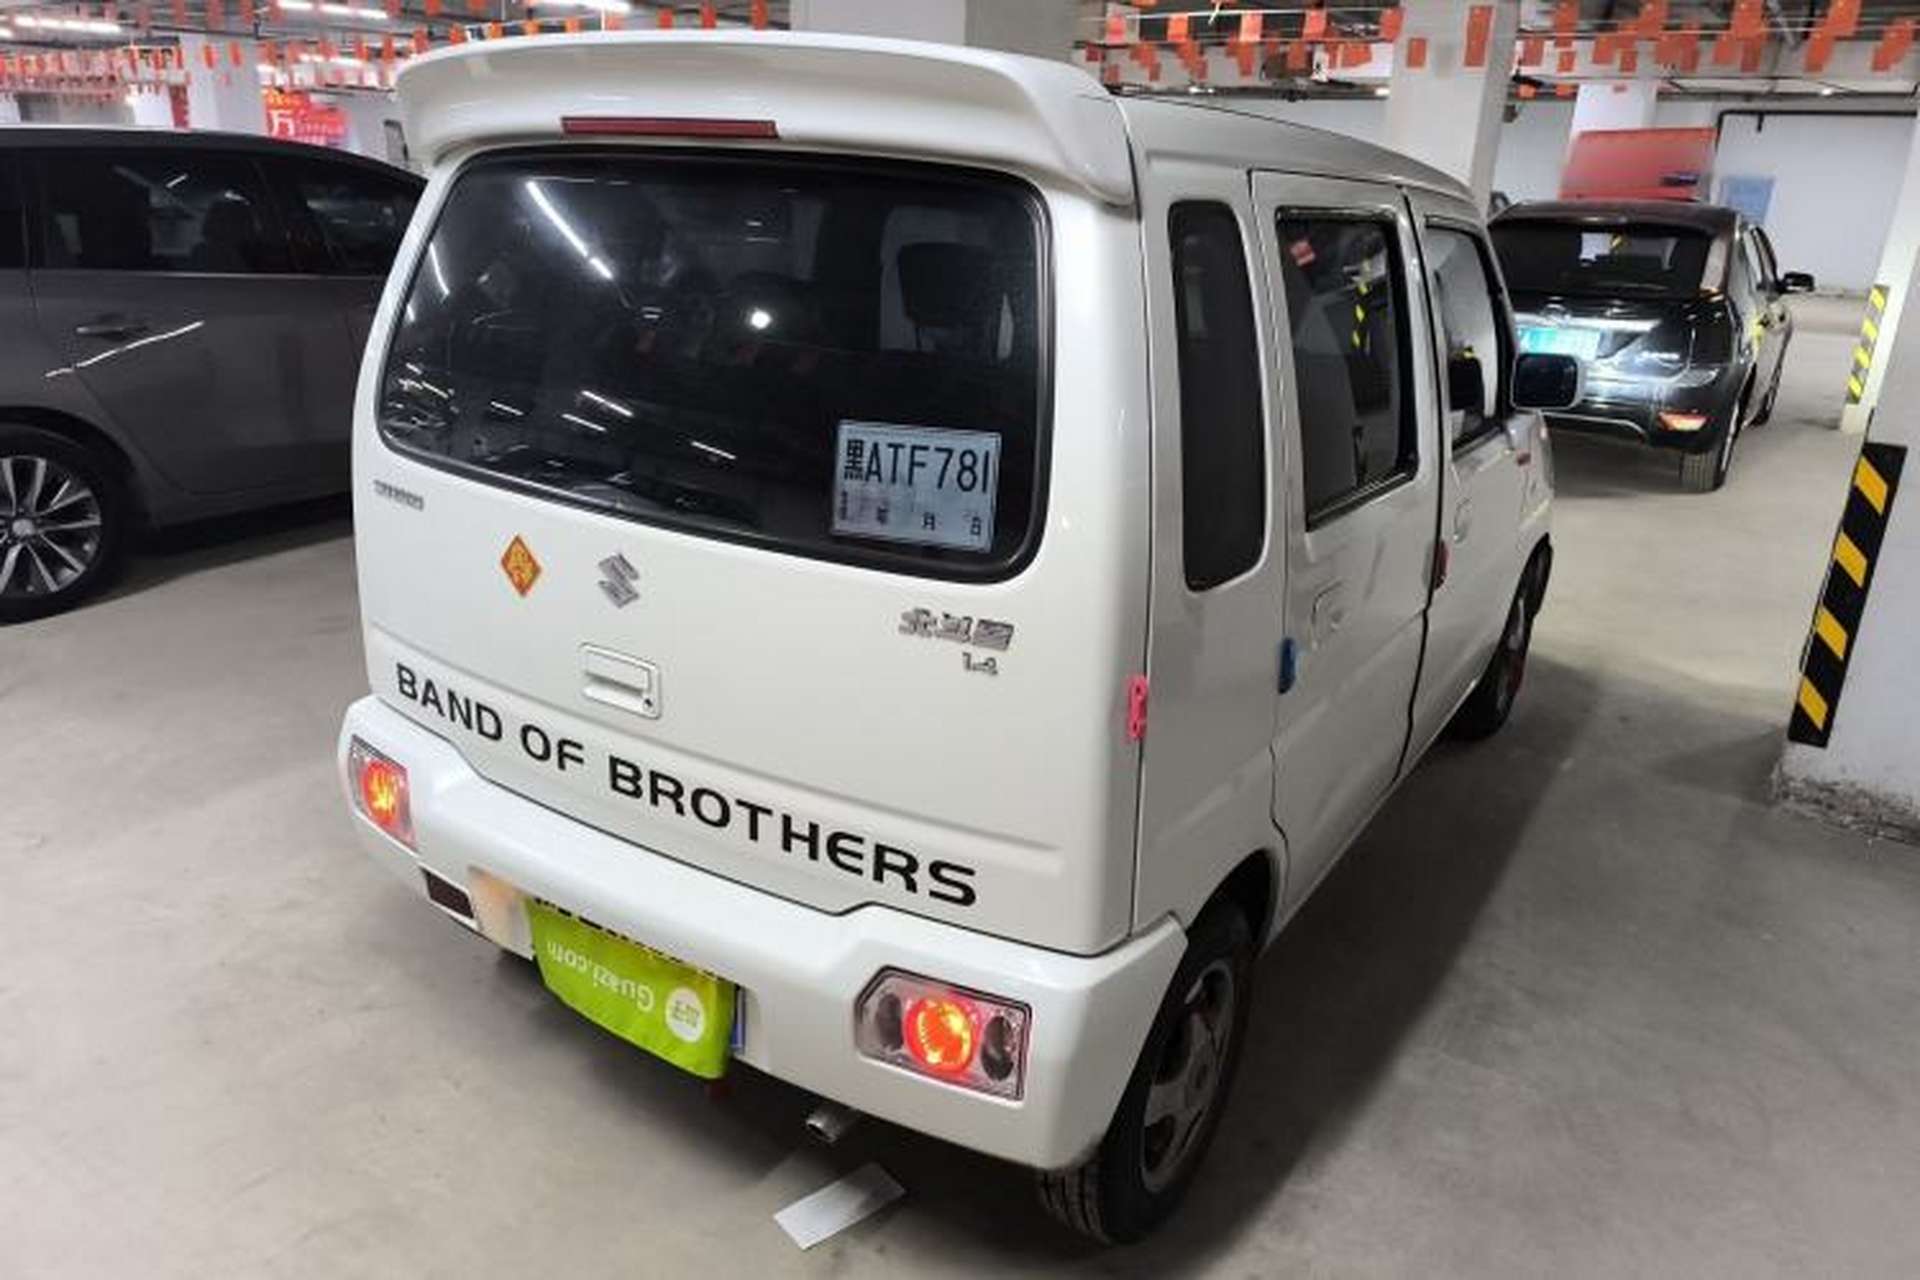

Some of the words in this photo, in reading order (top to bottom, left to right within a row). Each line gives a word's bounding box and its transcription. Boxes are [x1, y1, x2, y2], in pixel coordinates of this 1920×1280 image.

[844, 438, 990, 494] 黑ATF781
[396, 662, 502, 742] BAND
[520, 722, 585, 772] OF
[608, 754, 977, 907] BROTHERS
[547, 940, 655, 1013] Guazi.com
